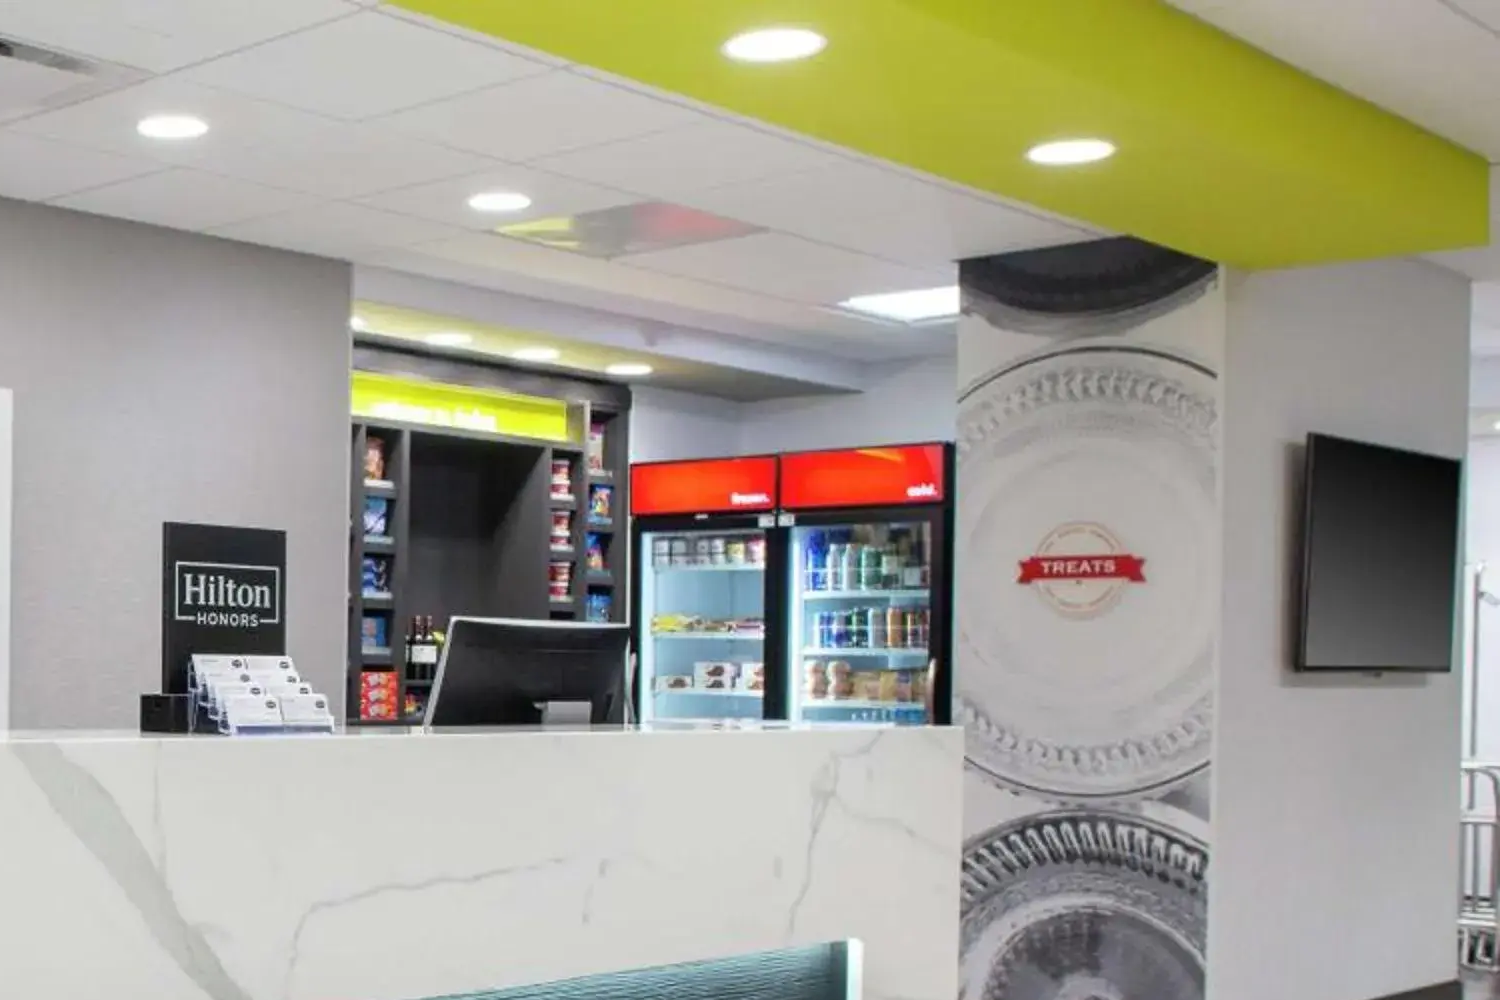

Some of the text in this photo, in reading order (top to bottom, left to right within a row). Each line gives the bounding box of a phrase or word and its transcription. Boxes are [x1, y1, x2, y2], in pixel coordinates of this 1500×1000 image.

[1040, 559, 1116, 575] TREATS
[183, 573, 271, 609] Hilton
[197, 612, 259, 627] HONORS
